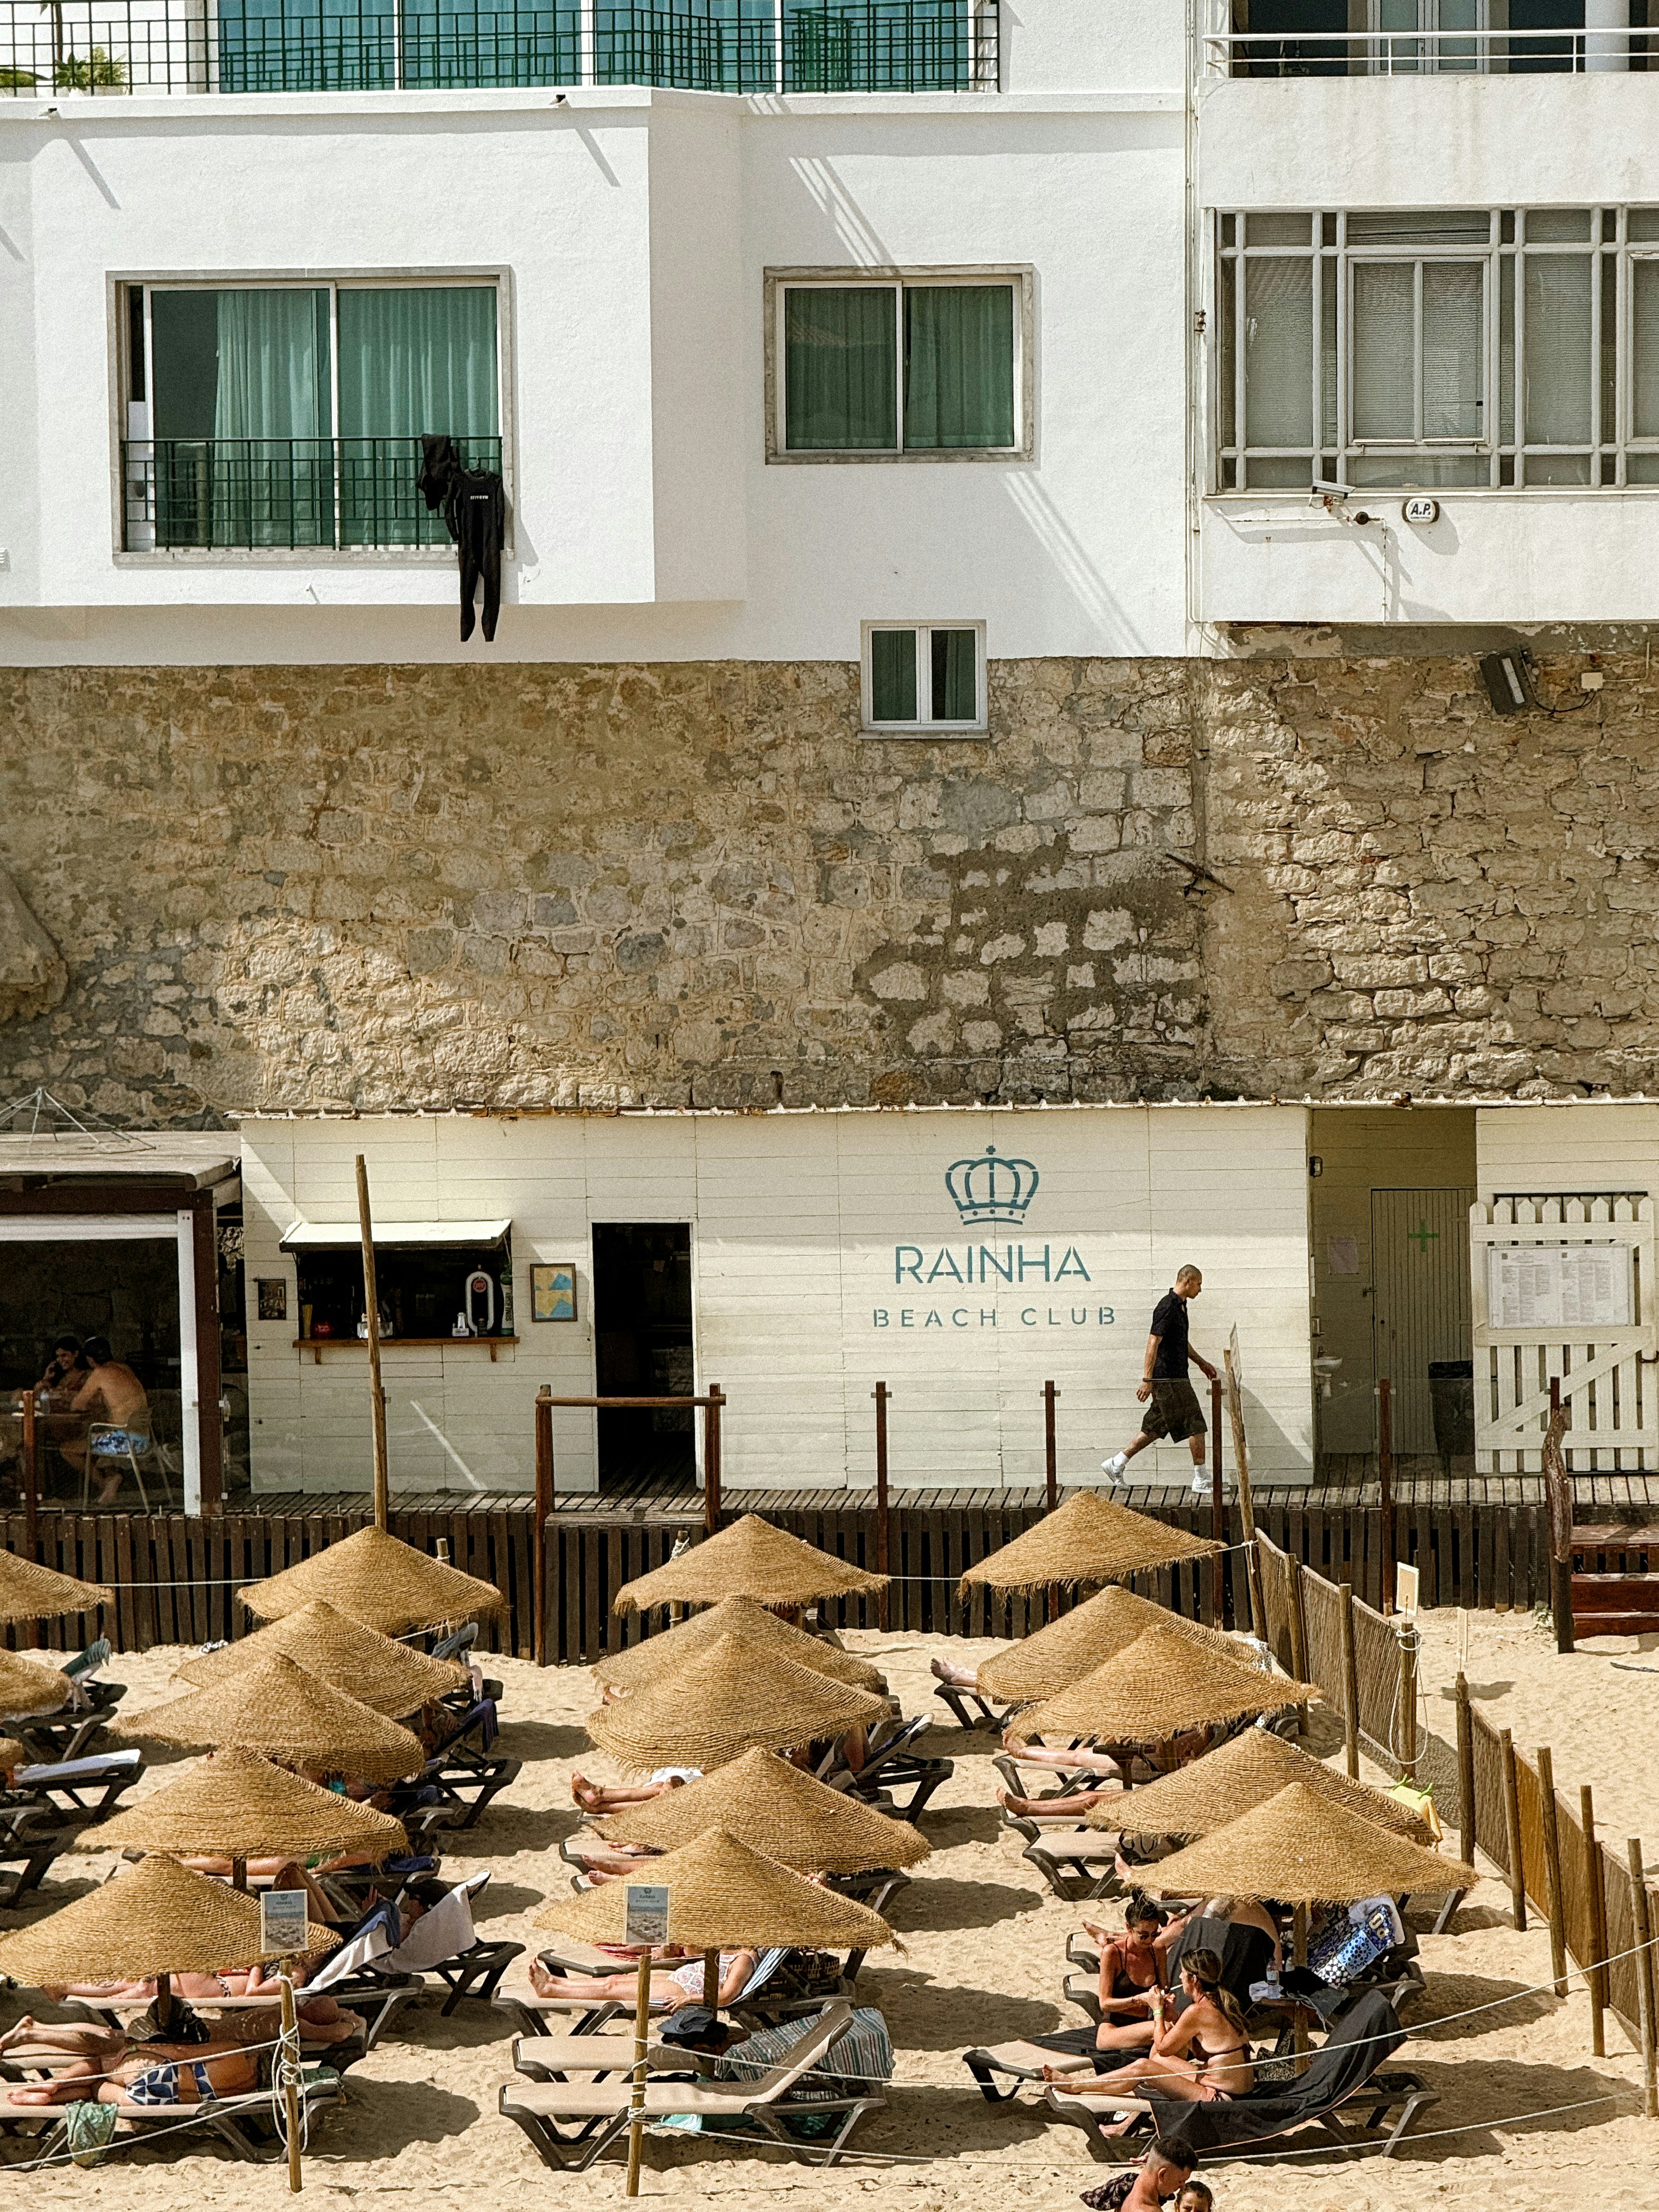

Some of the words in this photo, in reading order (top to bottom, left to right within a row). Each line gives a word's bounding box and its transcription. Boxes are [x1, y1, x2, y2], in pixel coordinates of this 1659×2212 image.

[1410, 503, 1431, 515] A.P.
[895, 1245, 1091, 1284] RAINHA
[874, 1308, 996, 1327] BEACH
[1021, 1307, 1115, 1326] CLUB
